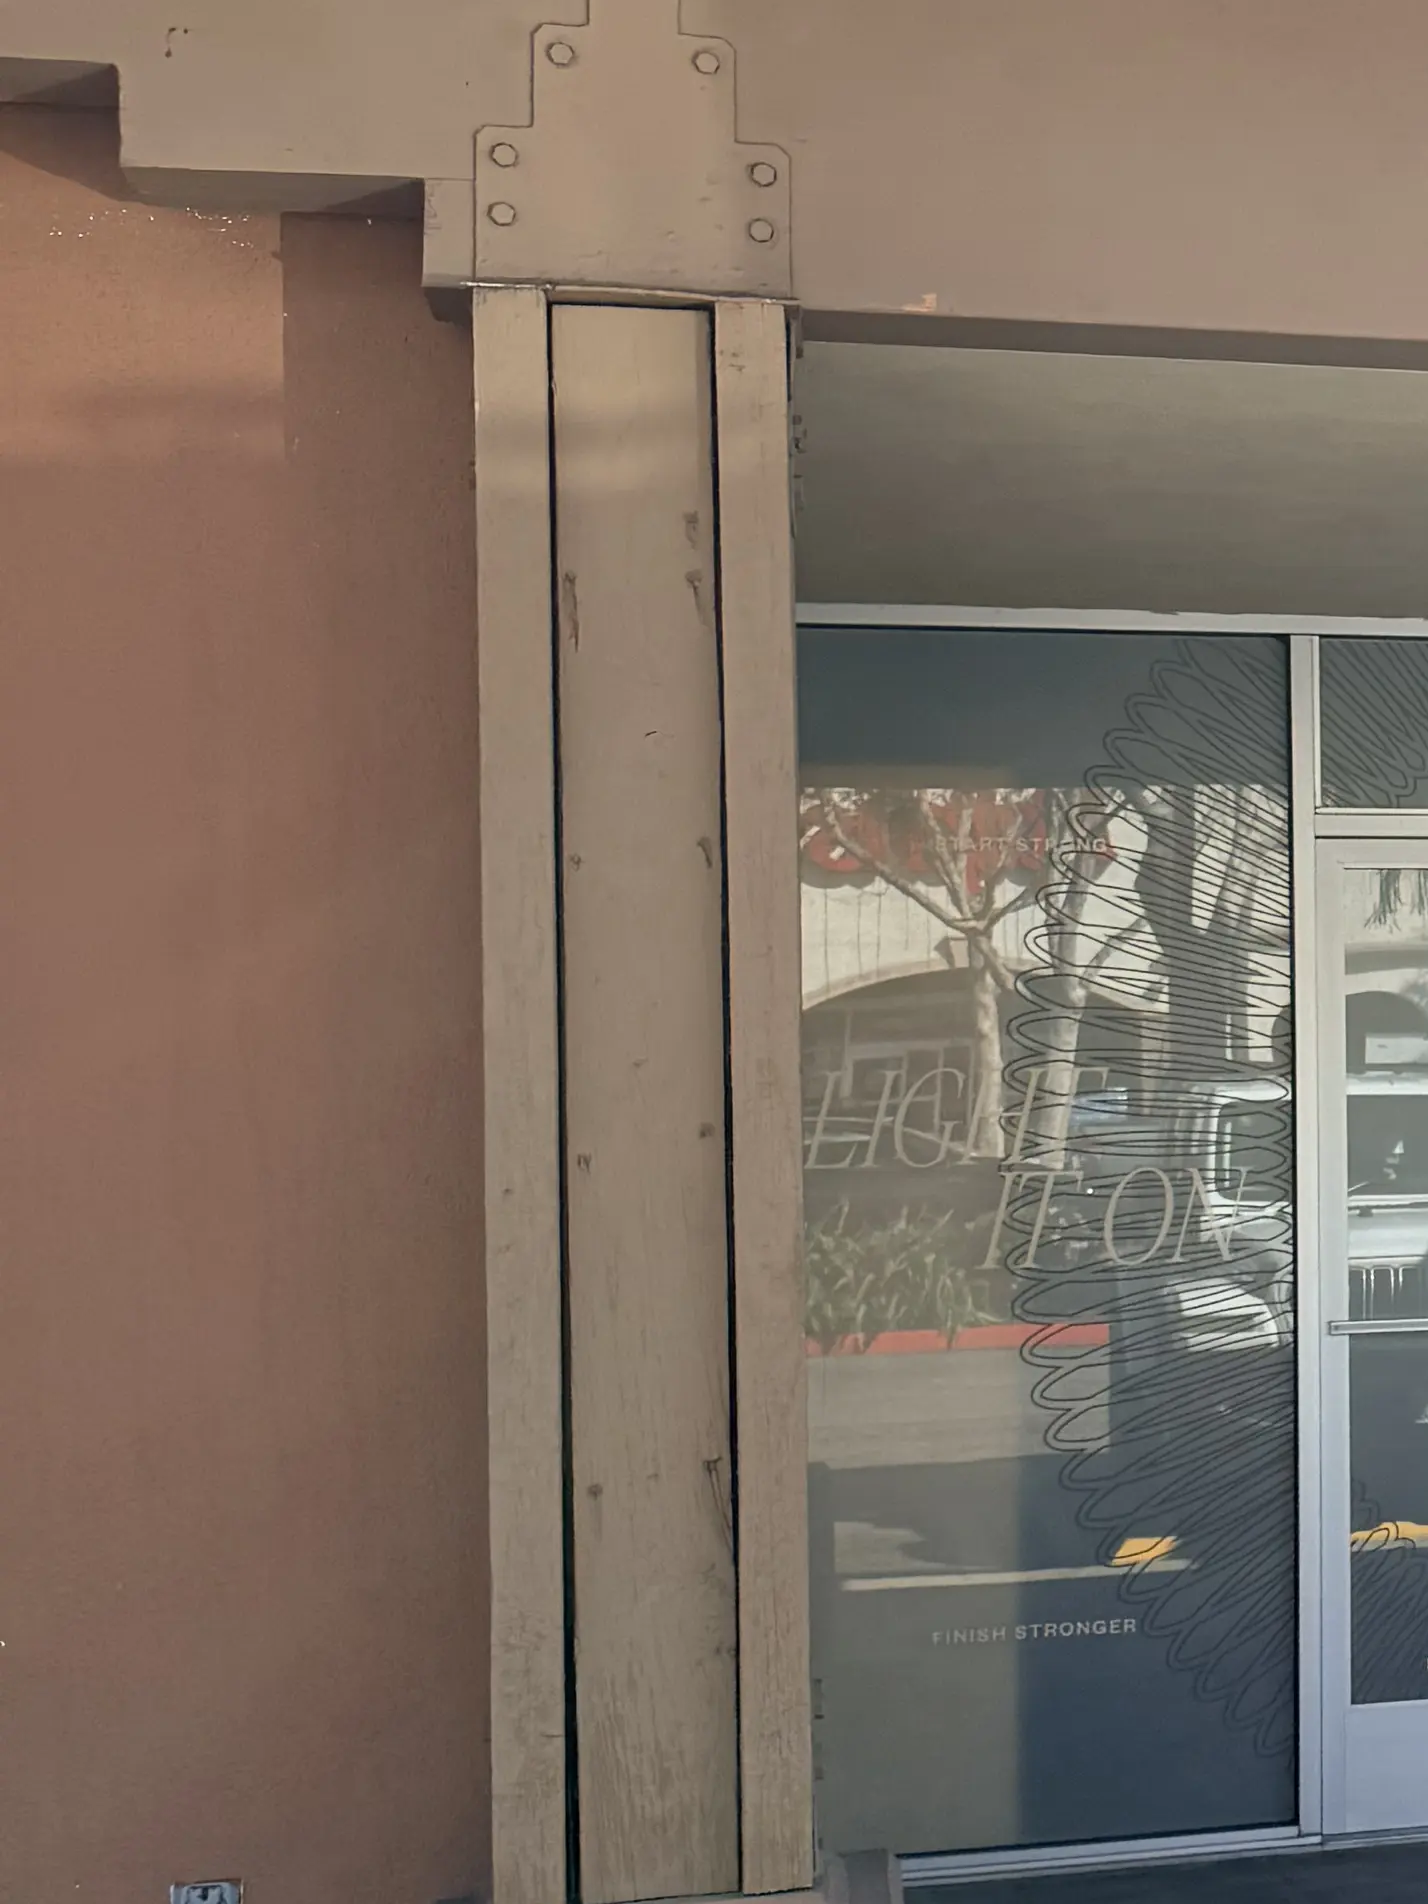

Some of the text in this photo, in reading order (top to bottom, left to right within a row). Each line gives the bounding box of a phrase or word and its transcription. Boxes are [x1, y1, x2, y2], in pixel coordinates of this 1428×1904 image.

[974, 1167, 1247, 1270] IT ON
[932, 1618, 1137, 1645] FINISH STRONGER
